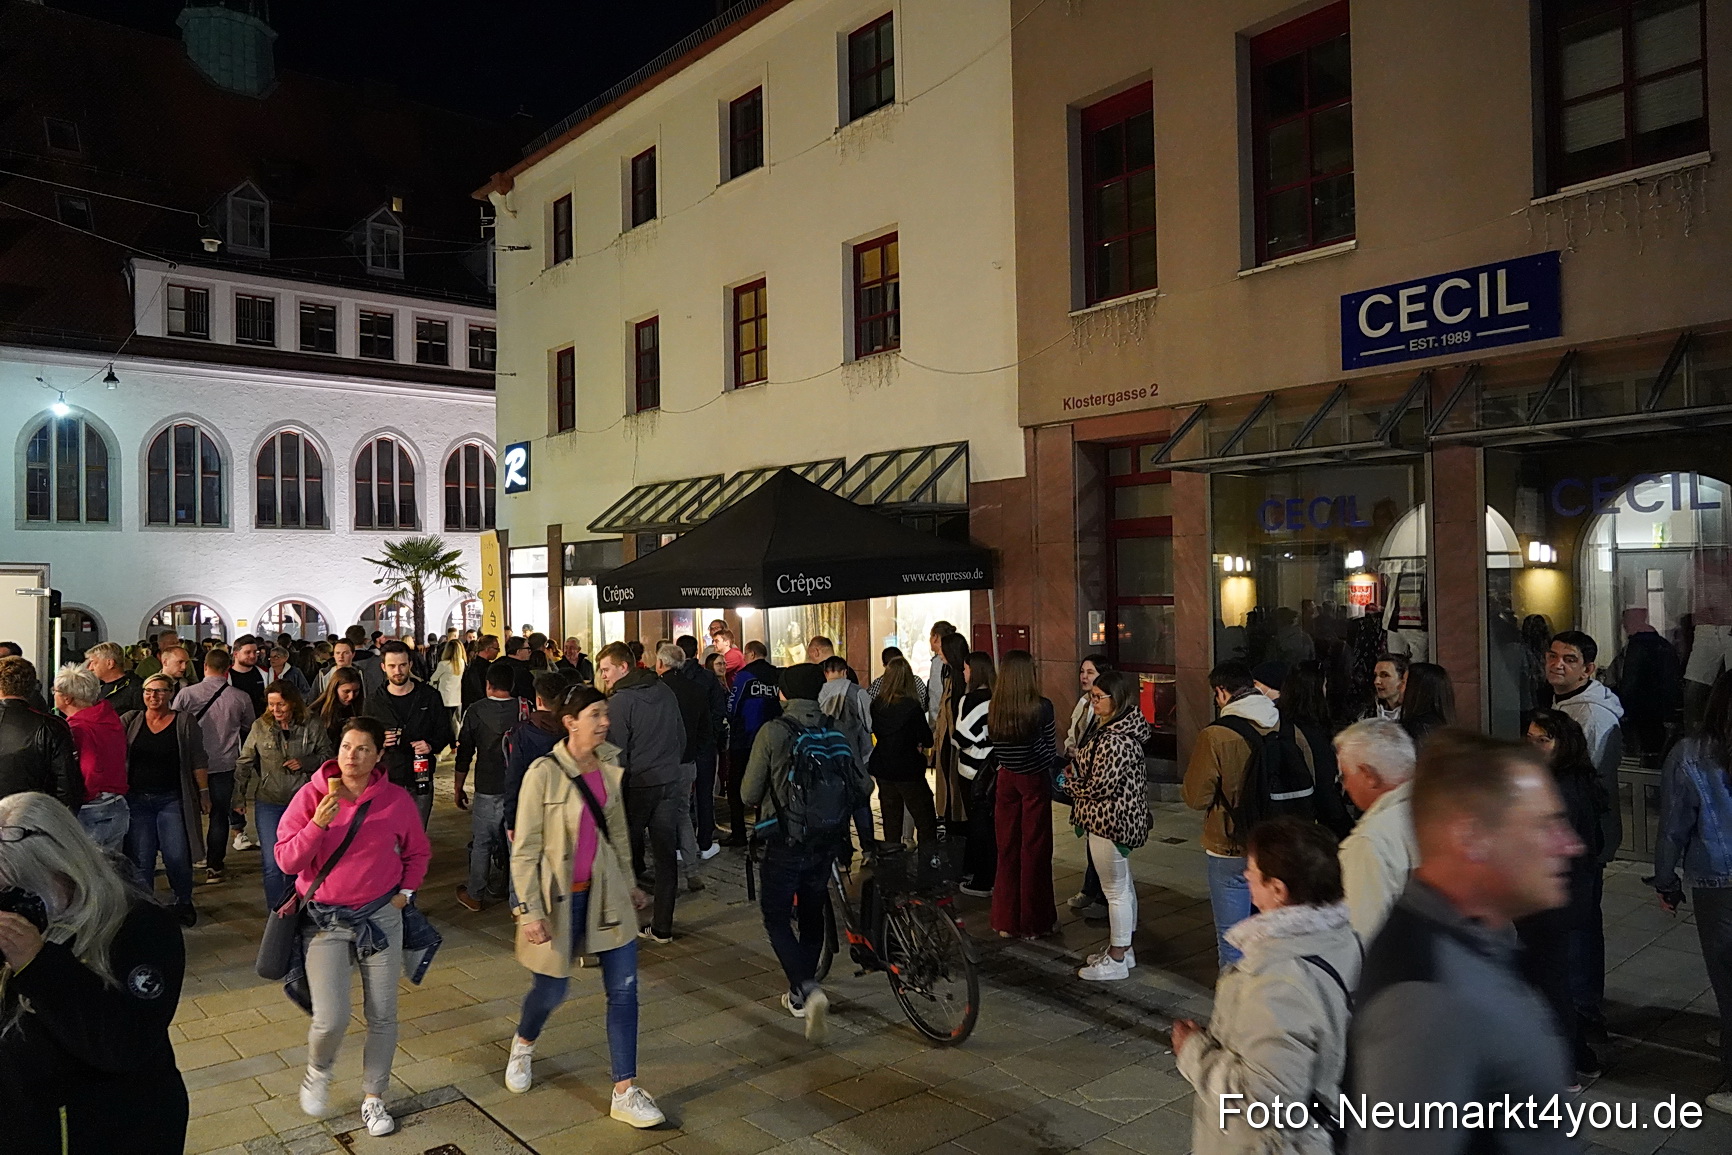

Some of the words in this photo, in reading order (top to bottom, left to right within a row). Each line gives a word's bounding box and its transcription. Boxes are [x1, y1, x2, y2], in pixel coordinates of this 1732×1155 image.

[1358, 268, 1529, 338] CECIL
[1409, 336, 1438, 351] EST.
[1440, 330, 1471, 346] 1989
[1063, 388, 1147, 411] Klostergasse
[1150, 383, 1159, 397] 2
[505, 447, 527, 488] R
[1552, 470, 1720, 517] CECIL
[1257, 494, 1371, 531] CECIL
[776, 573, 832, 596] Crêpes
[902, 568, 984, 583] www.creppresso.de
[602, 585, 634, 605] Crêpes
[681, 583, 752, 599] www.creppresso.de
